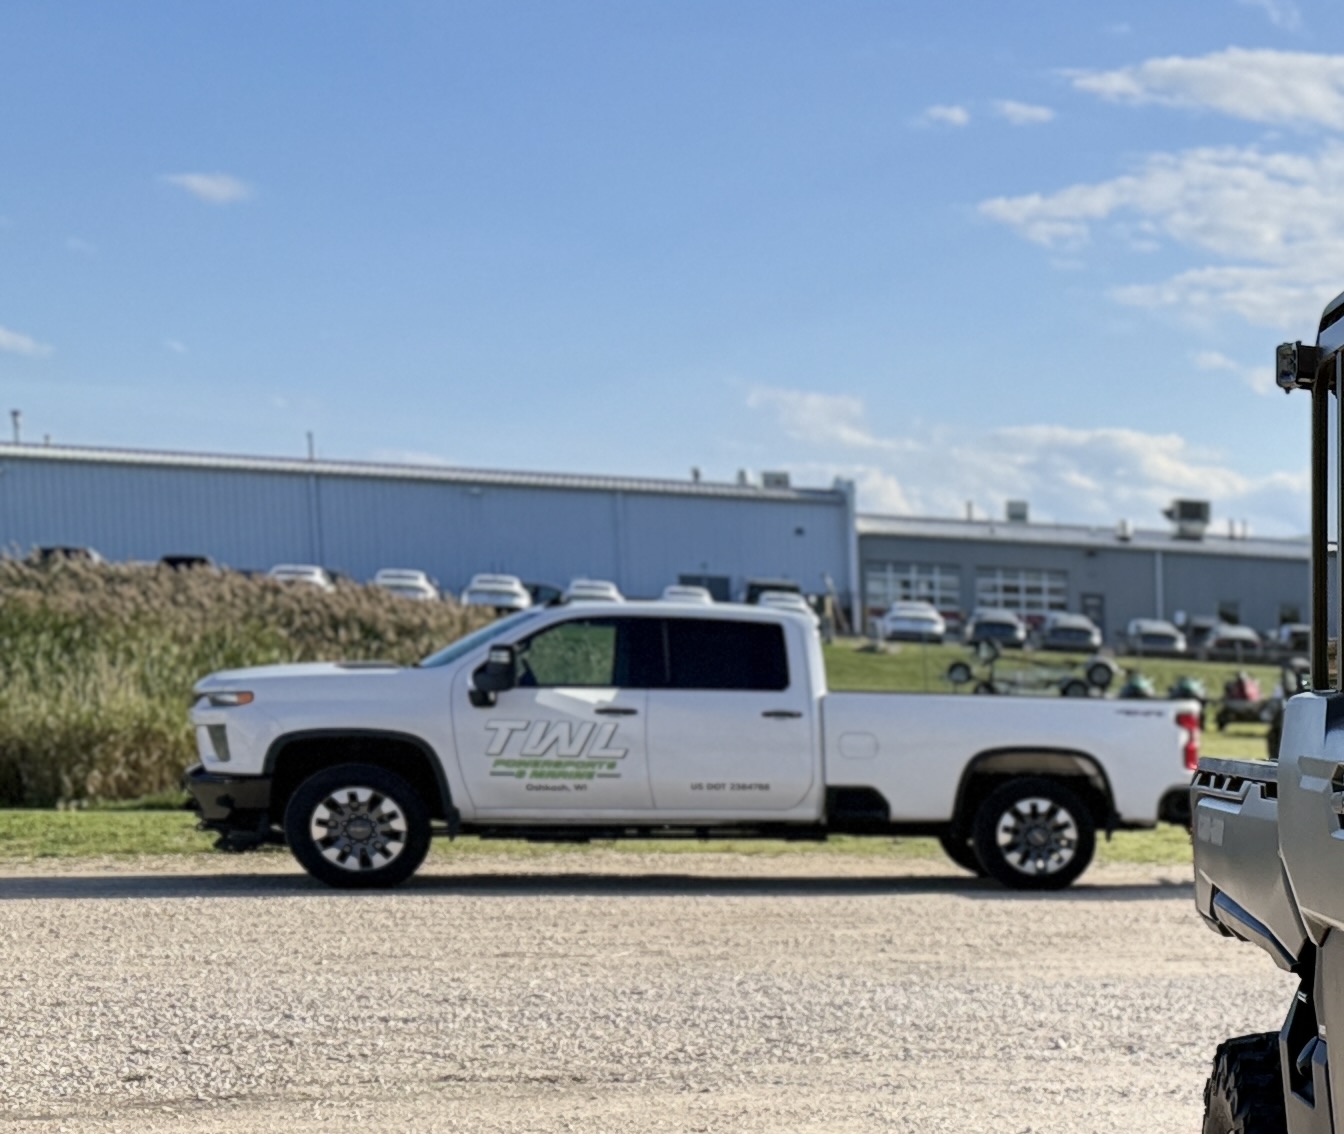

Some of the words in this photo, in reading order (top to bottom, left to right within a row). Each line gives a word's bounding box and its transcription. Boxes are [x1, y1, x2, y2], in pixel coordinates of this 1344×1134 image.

[484, 719, 629, 759] TWL
[690, 782, 704, 791] US
[706, 782, 726, 791] DOT
